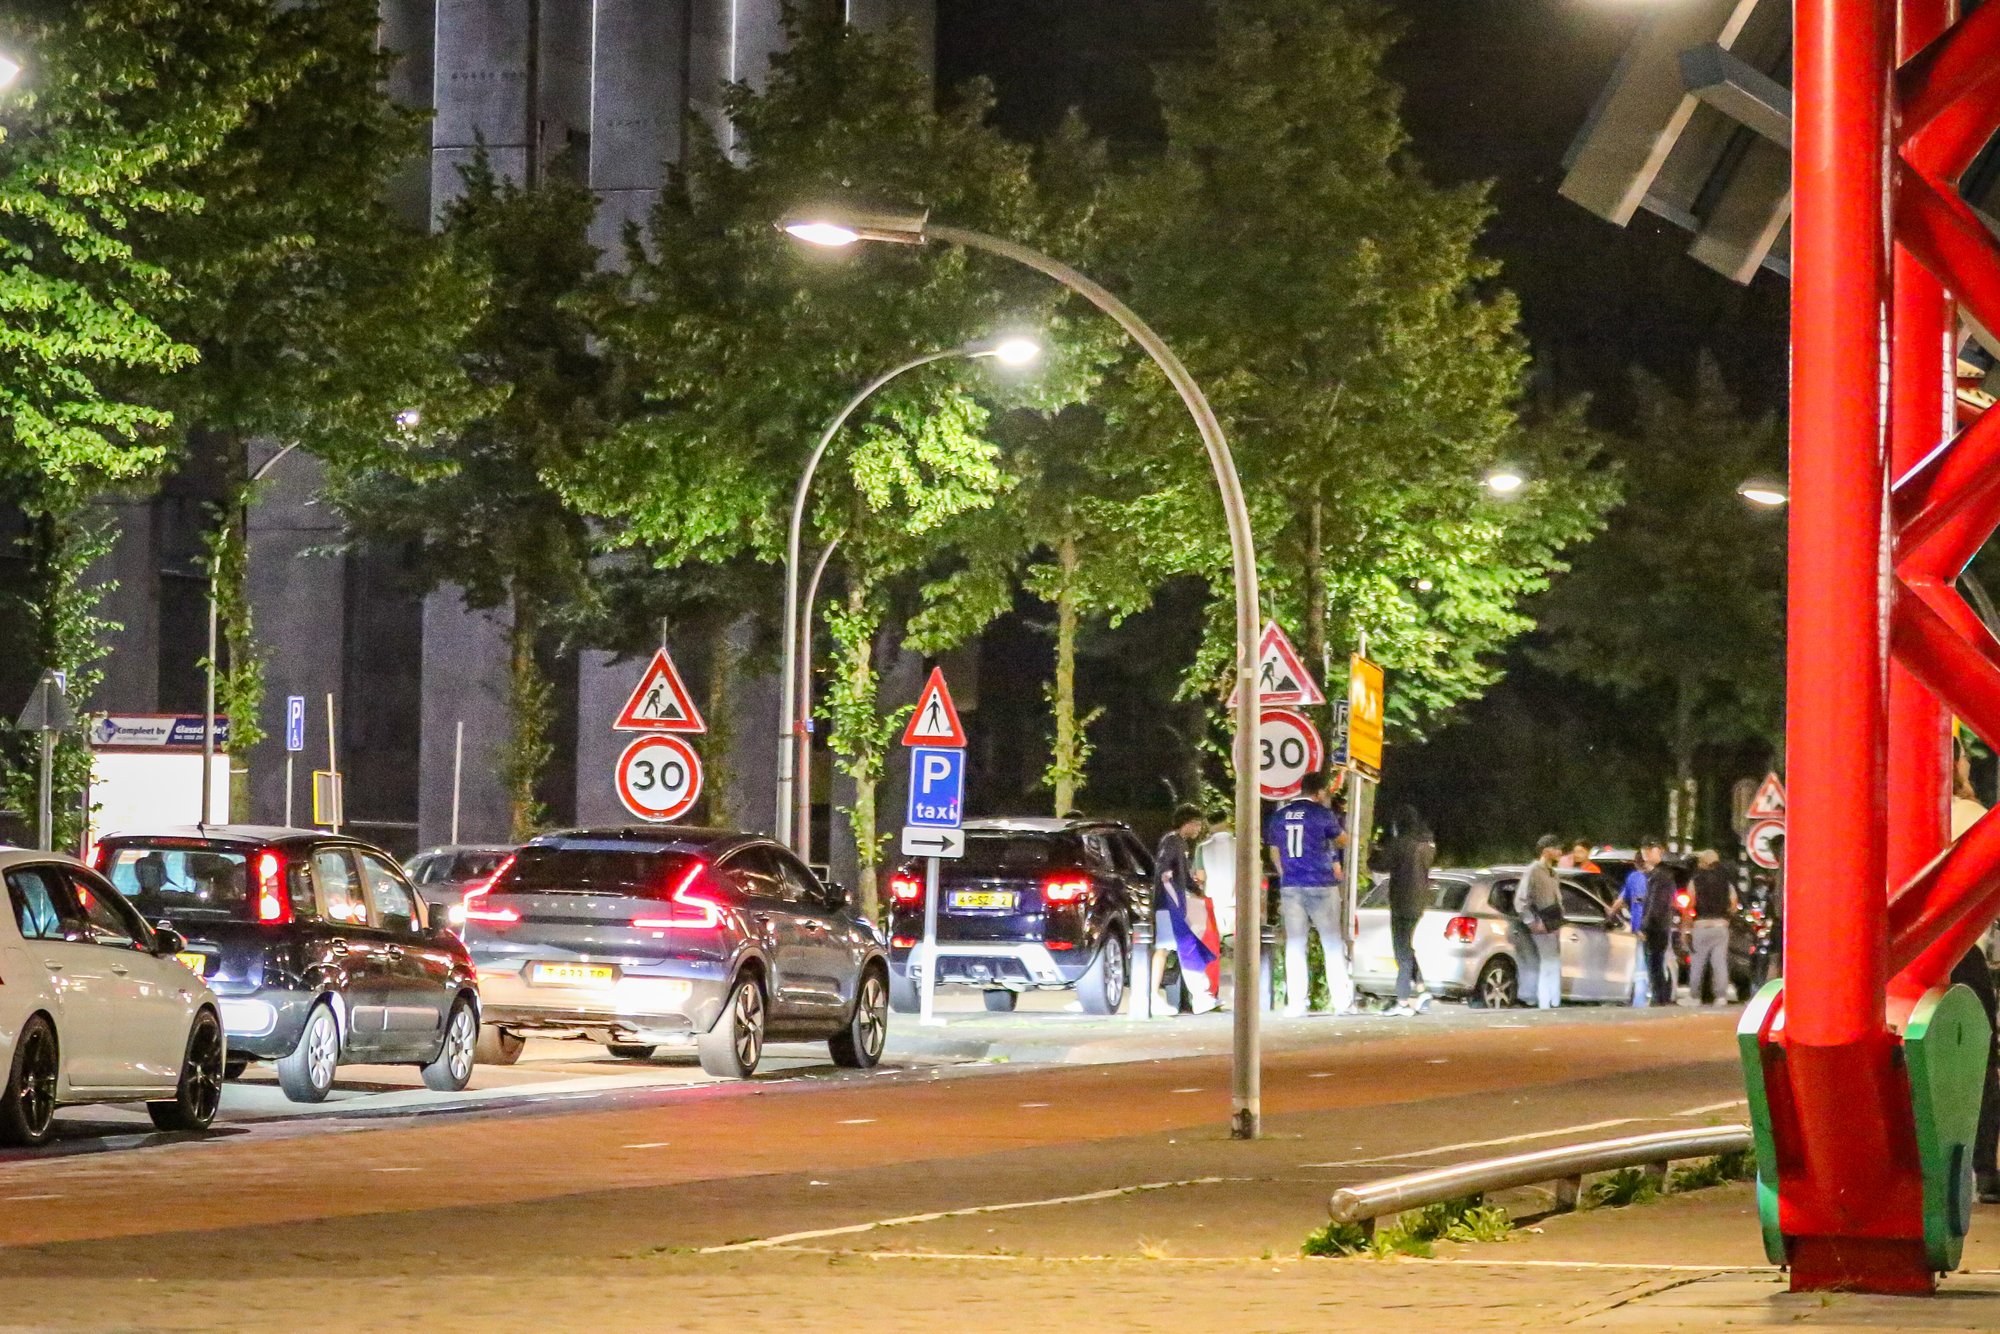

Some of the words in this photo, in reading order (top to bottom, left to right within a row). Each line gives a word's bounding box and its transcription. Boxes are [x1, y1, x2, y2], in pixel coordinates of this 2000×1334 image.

[117, 726, 155, 736] Compleet
[292, 702, 301, 729] P
[1260, 738, 1304, 771] 30
[632, 760, 684, 791] 30
[923, 755, 951, 794] P
[916, 802, 955, 820] taxi
[1284, 824, 1304, 858] 11
